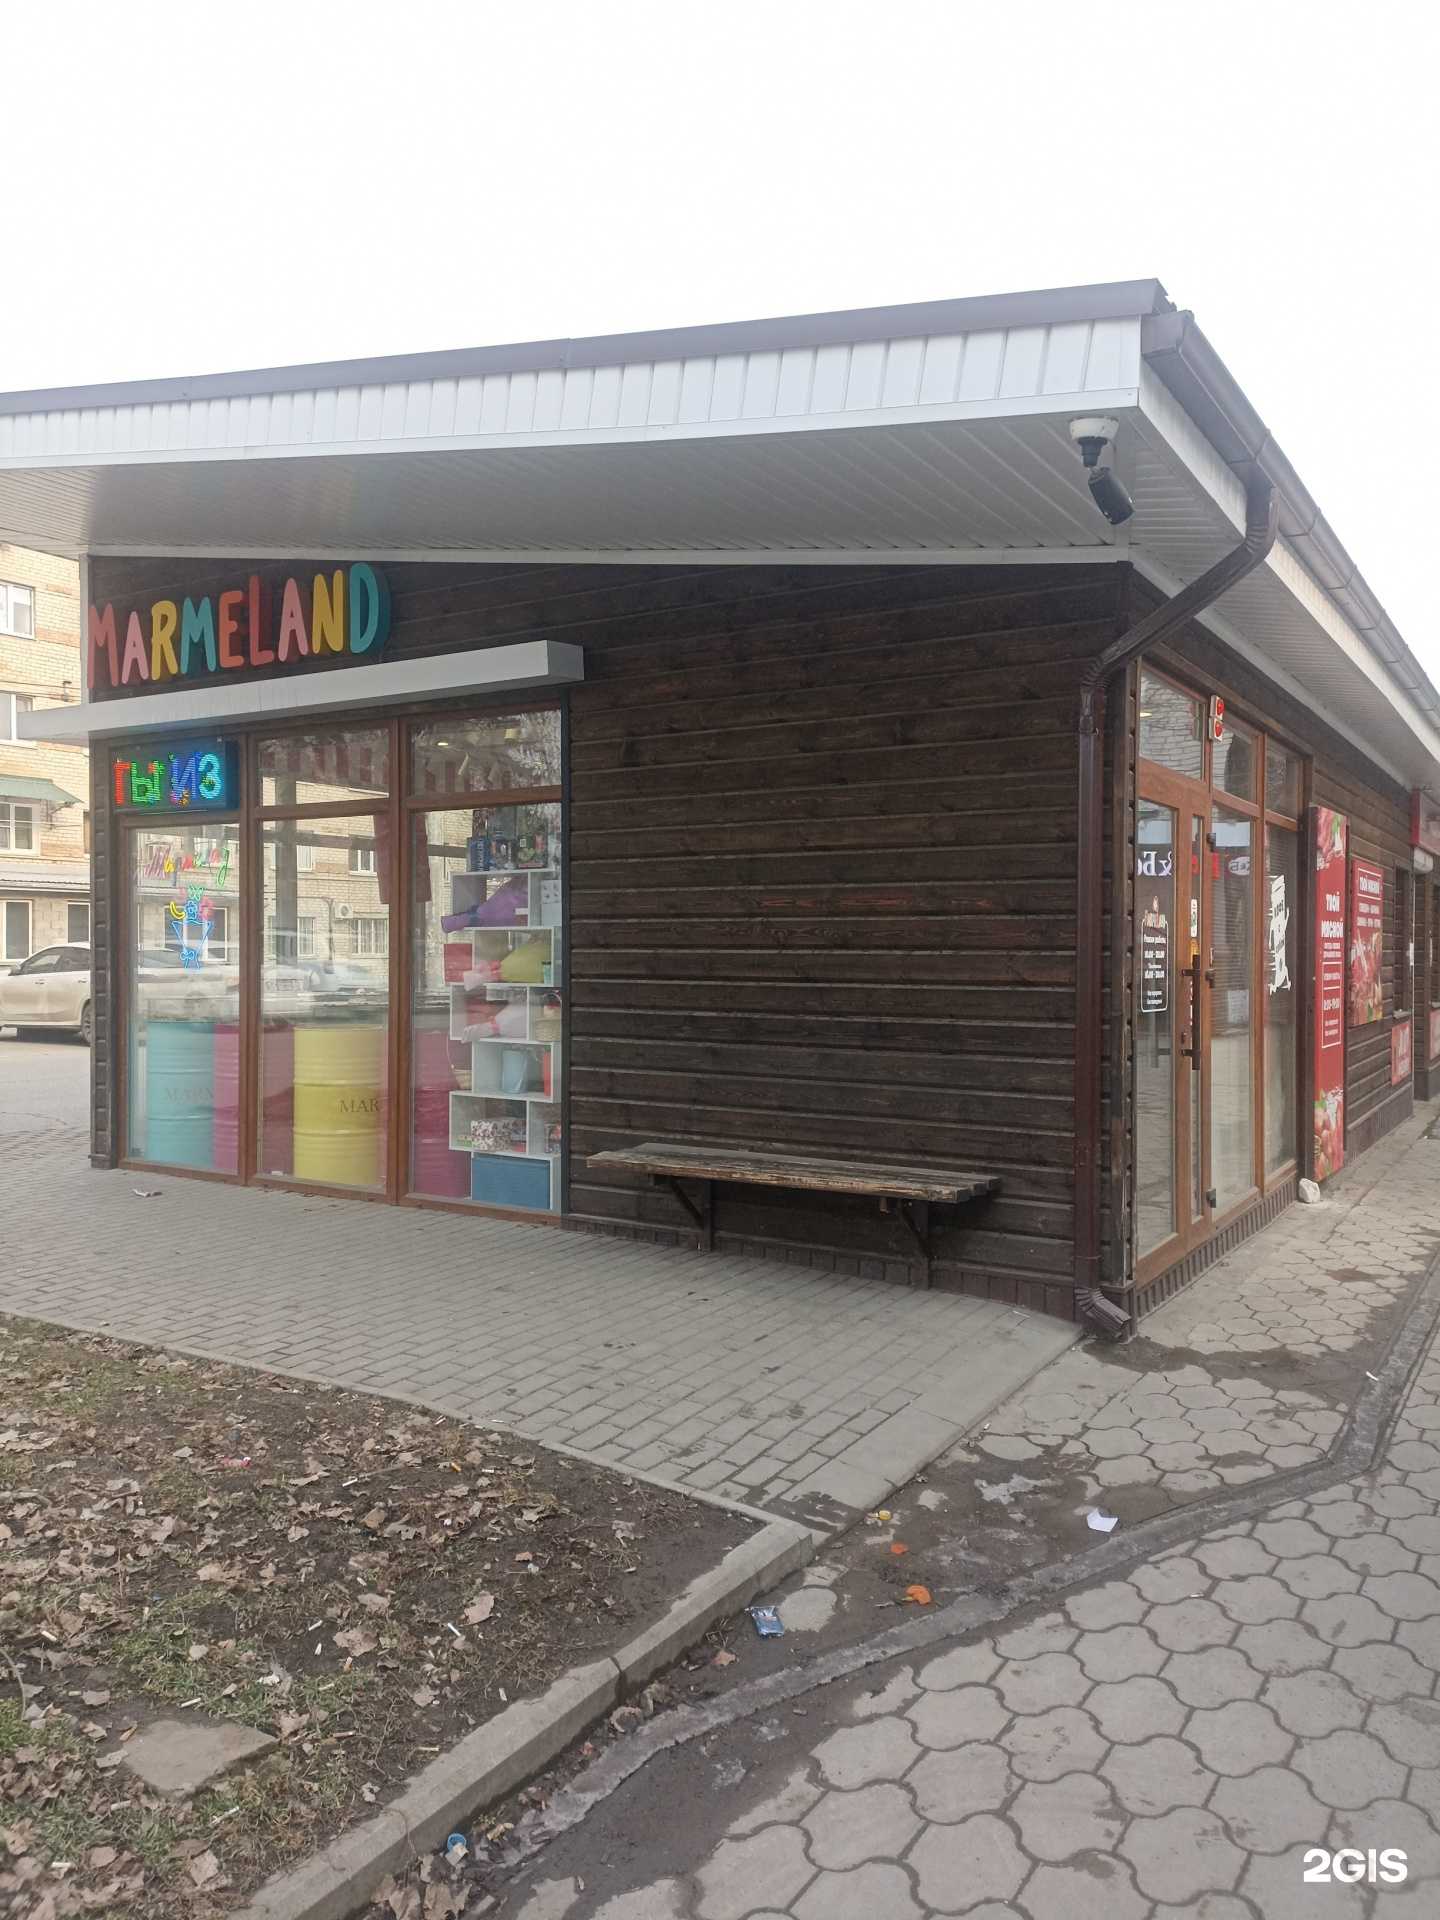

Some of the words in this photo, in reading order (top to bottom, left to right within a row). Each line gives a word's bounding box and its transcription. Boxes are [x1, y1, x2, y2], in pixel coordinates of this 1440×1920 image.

[87, 562, 382, 689] MARMELAND
[171, 752, 223, 802] ИЗ
[1326, 890, 1340, 912] ТВОЙ
